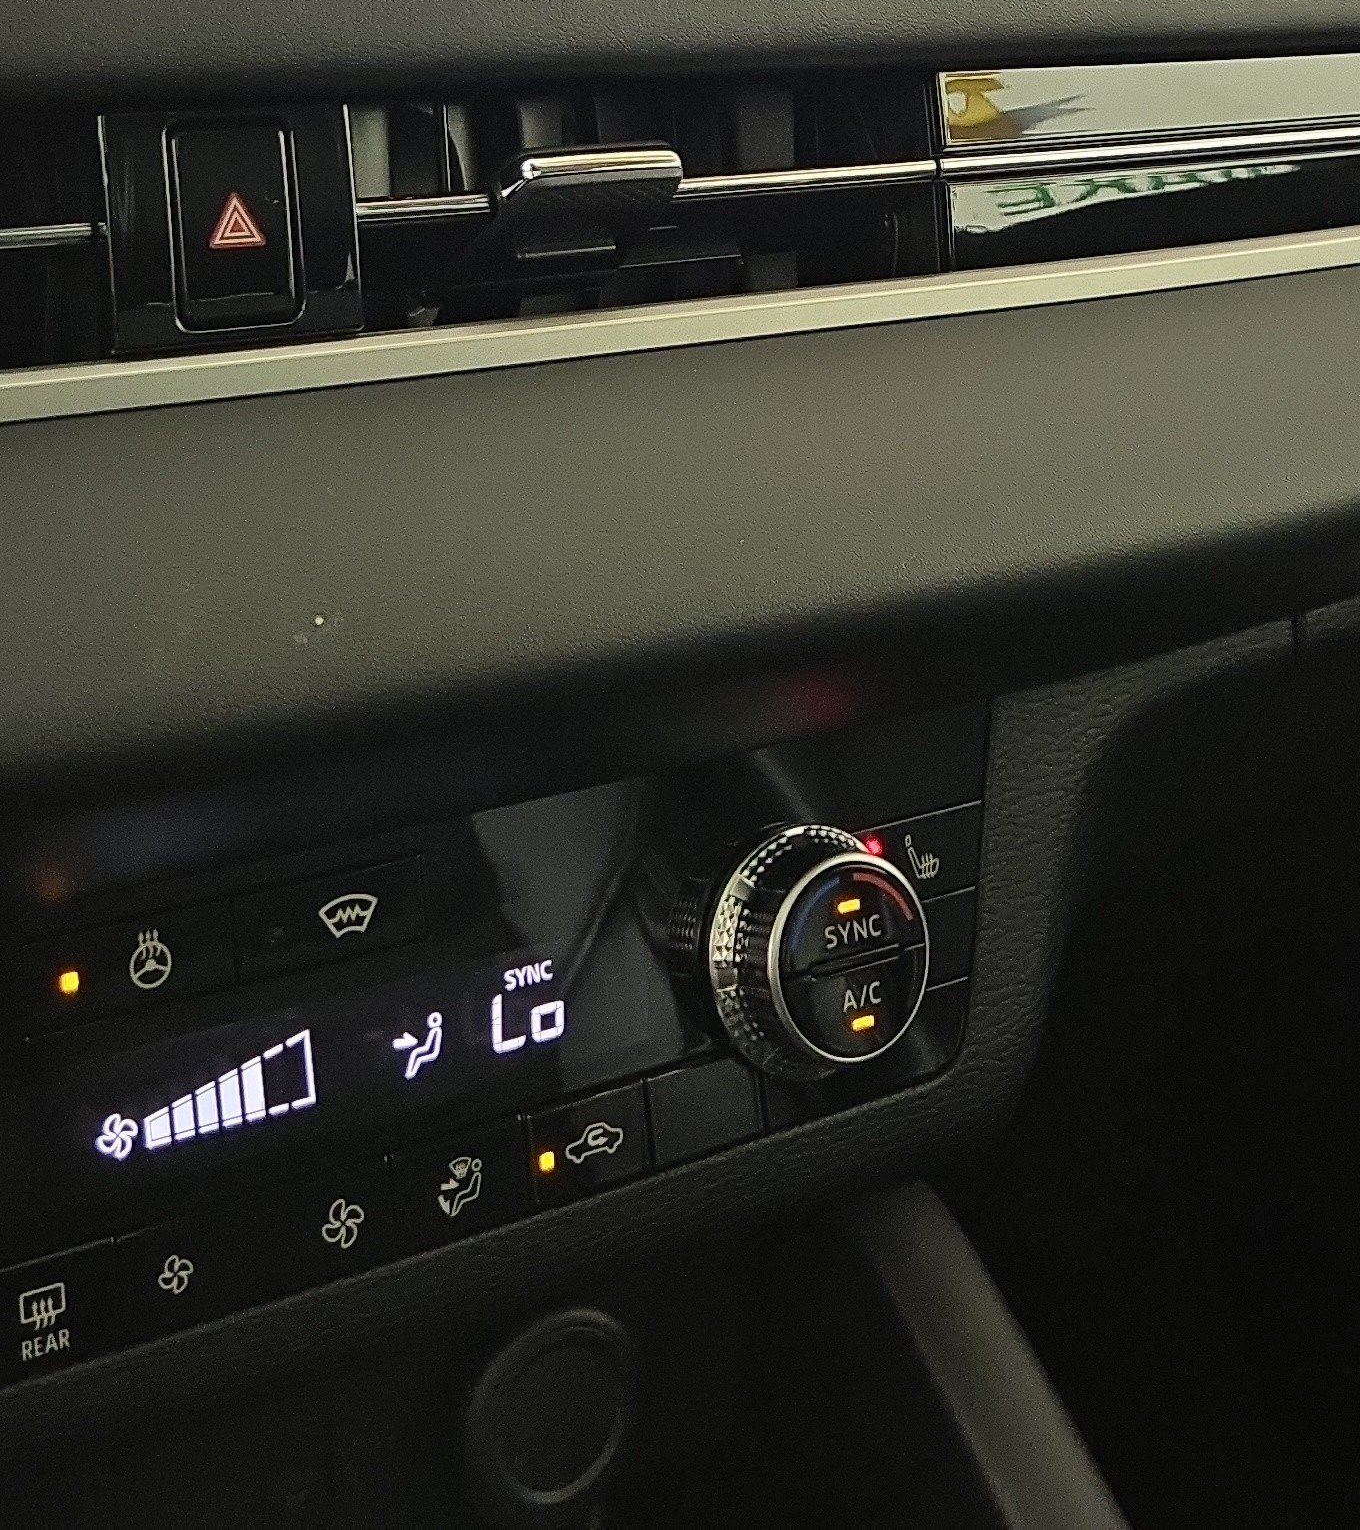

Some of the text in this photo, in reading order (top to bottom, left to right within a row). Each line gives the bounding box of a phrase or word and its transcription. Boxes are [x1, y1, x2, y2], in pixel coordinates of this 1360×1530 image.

[823, 913, 883, 951] SYNC
[504, 959, 554, 992] SYNC
[841, 980, 883, 1013] A/C
[490, 992, 566, 1055] Lo
[21, 1328, 71, 1362] REAR
